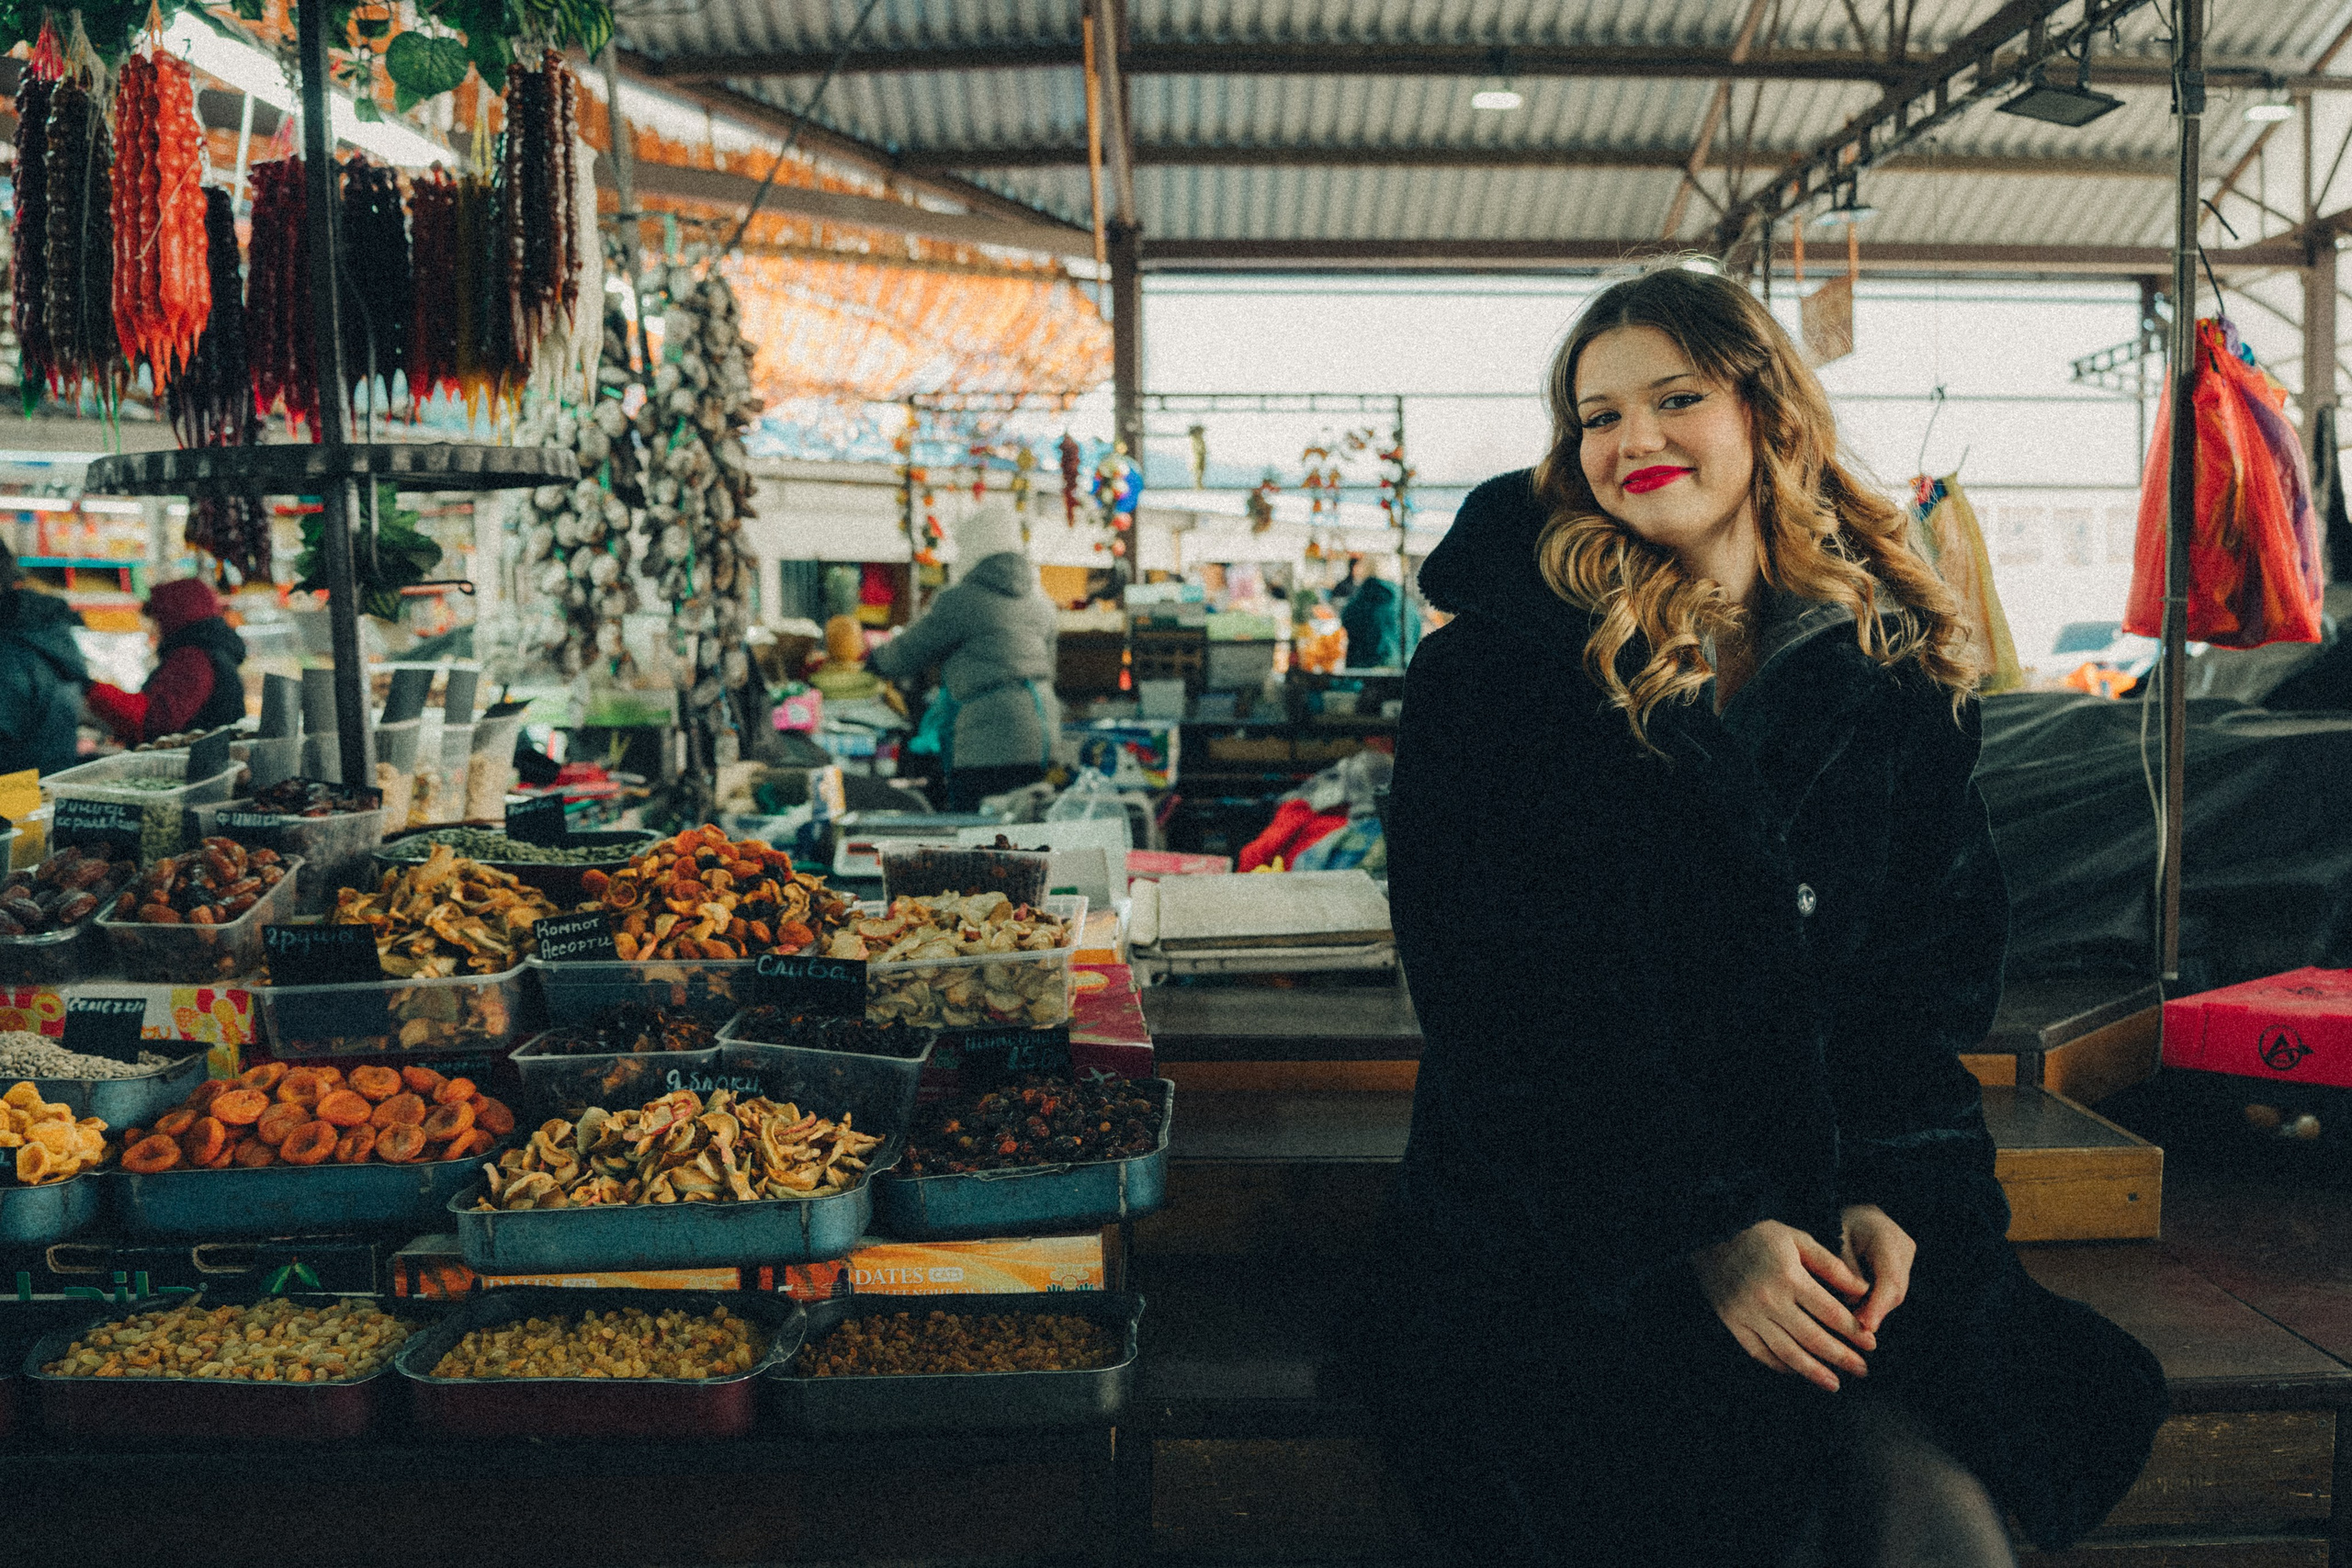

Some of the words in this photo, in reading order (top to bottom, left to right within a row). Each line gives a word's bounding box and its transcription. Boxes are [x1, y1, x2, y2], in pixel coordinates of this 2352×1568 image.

[536, 918, 600, 939] Компот
[541, 936, 614, 960] Ассорти
[855, 1268, 923, 1286] DATES
